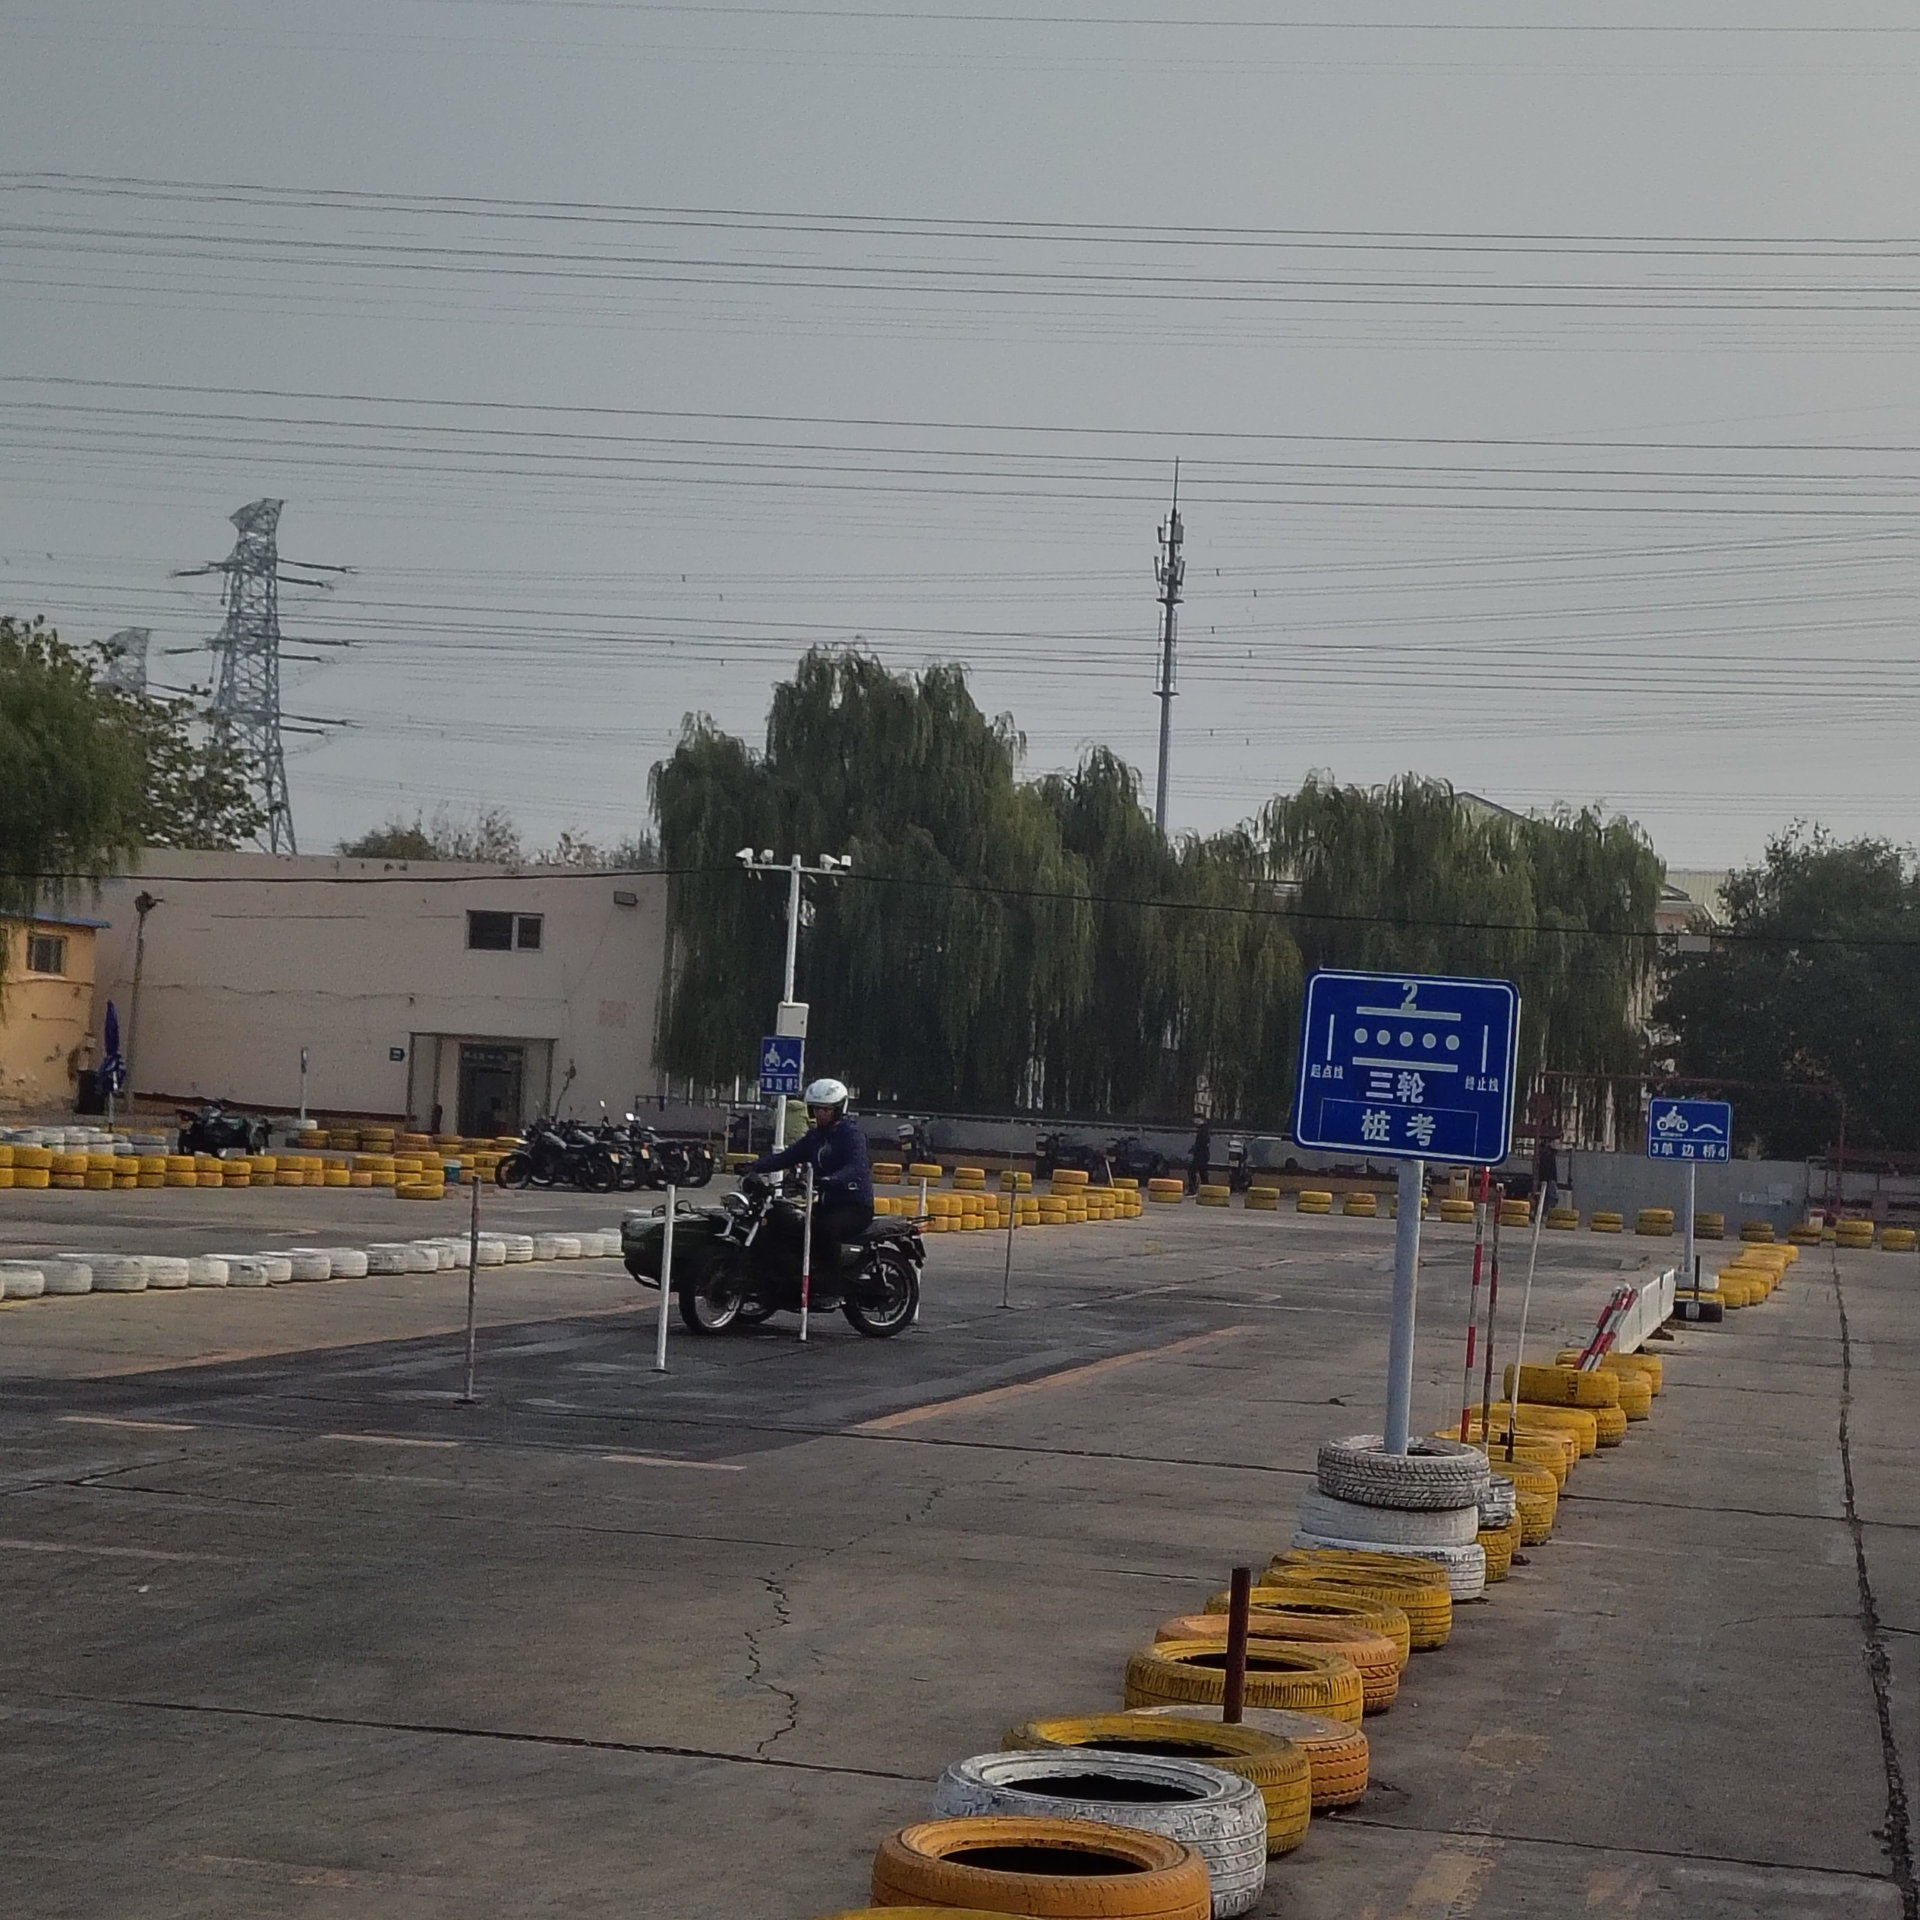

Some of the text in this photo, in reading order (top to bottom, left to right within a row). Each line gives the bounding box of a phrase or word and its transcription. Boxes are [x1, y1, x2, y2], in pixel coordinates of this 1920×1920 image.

[1402, 981, 1418, 1010] 2
[1310, 1064, 1344, 1080] 起点线
[1465, 1075, 1499, 1093] 终止线
[1365, 1071, 1426, 1104] 三轮
[1361, 1108, 1436, 1147] 桩考
